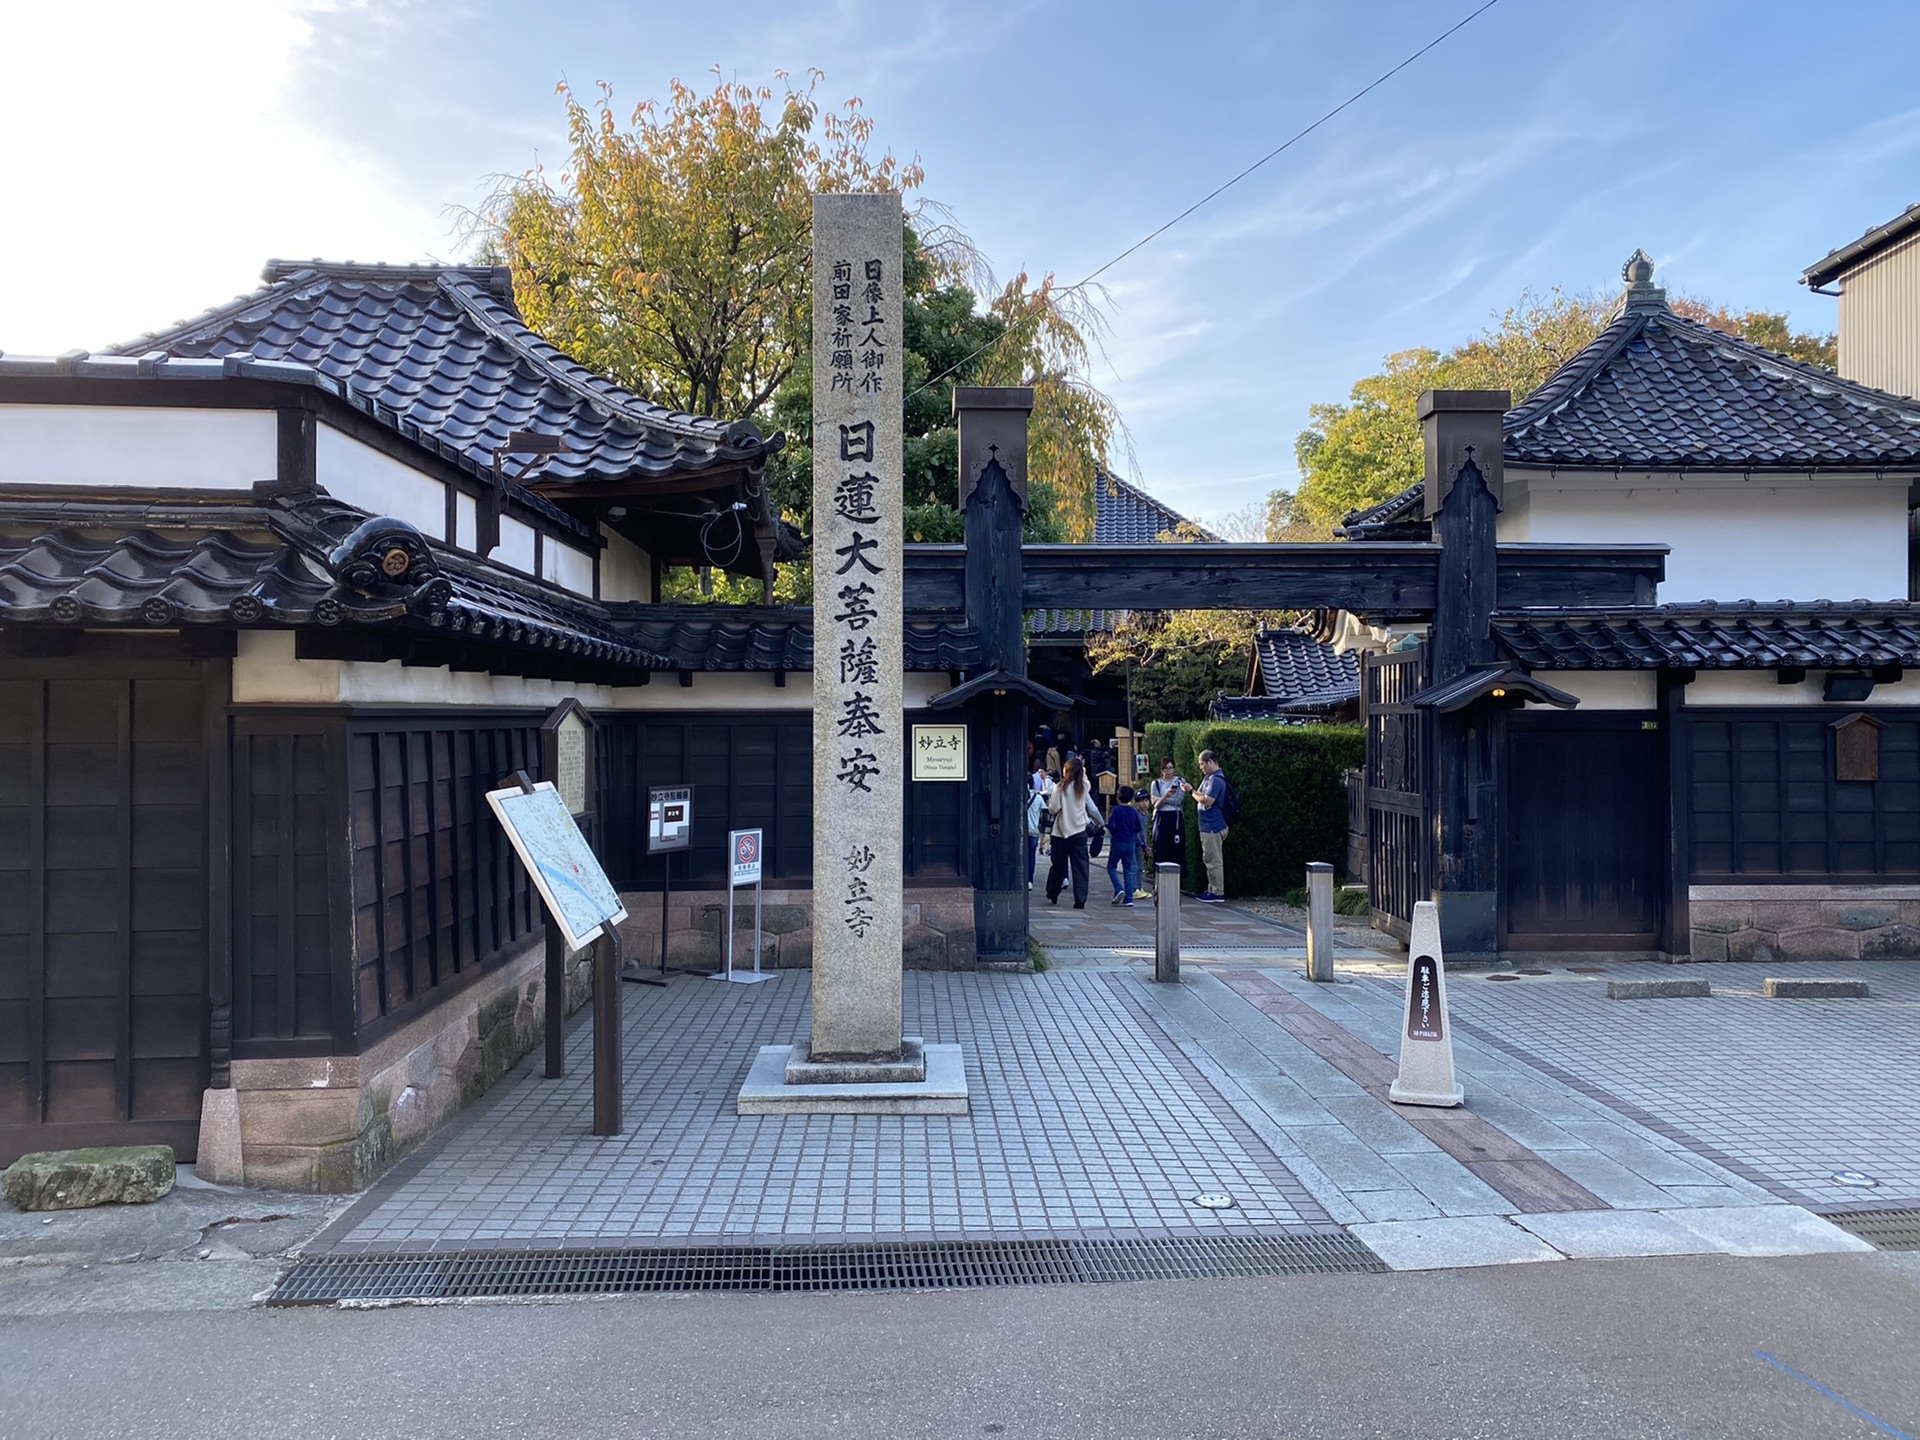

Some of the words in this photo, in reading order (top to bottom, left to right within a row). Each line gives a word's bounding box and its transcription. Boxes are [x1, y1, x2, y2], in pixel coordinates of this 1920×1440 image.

[830, 260, 855, 393] 前田家祈願所
[859, 258, 886, 393] 日像上人御作
[834, 420, 885, 794] 日蓮大菩薩奉安
[918, 735, 961, 751] 妙立寺
[845, 845, 875, 939] 妙立寺
